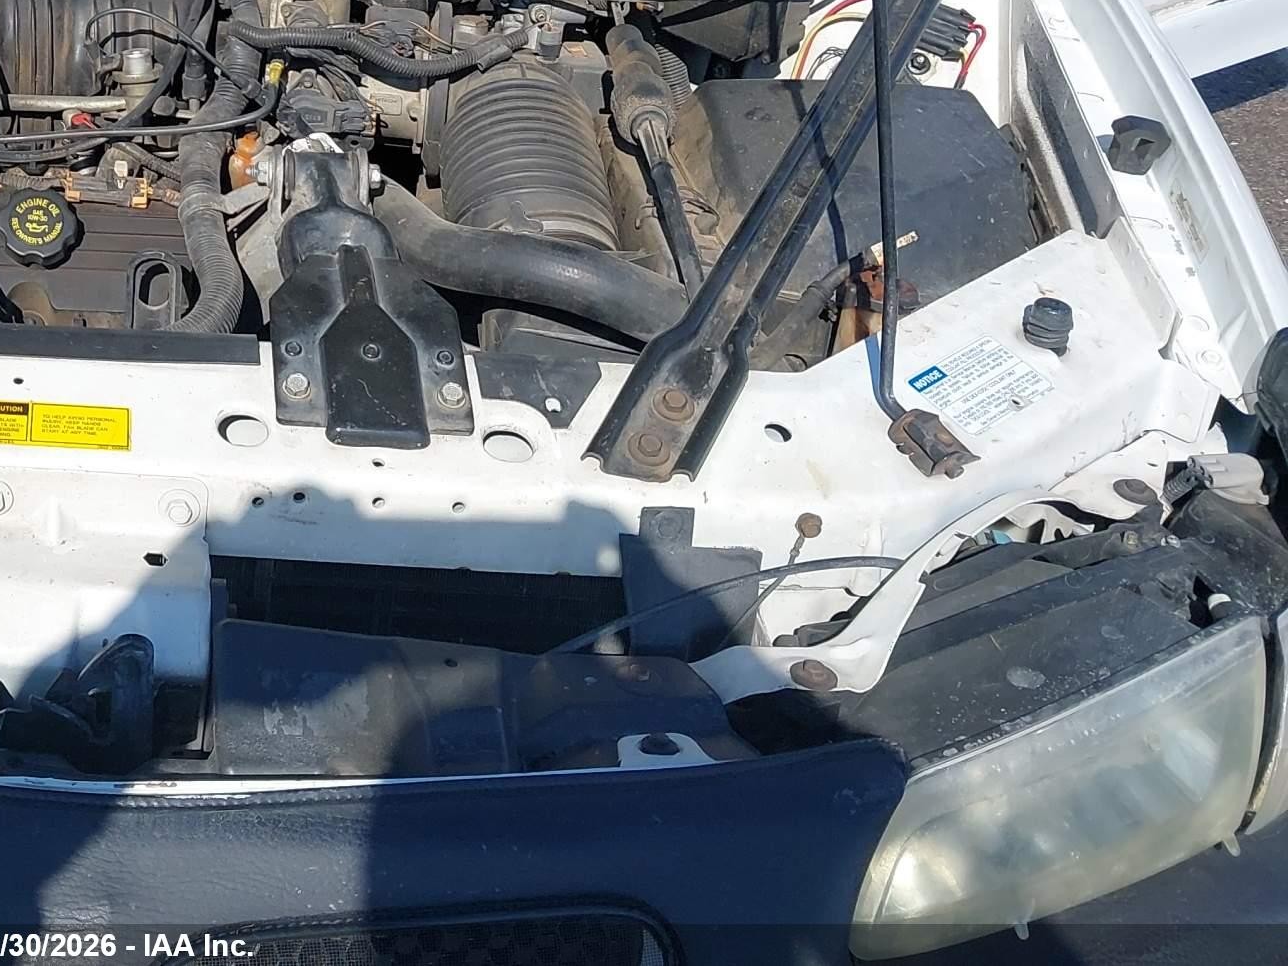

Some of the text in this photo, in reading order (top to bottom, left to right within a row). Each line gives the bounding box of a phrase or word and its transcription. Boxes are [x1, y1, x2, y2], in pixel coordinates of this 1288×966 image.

[15, 197, 61, 218] ENGINE OIL
[44, 221, 63, 243] MANUAL
[914, 370, 943, 389] NOTICE
